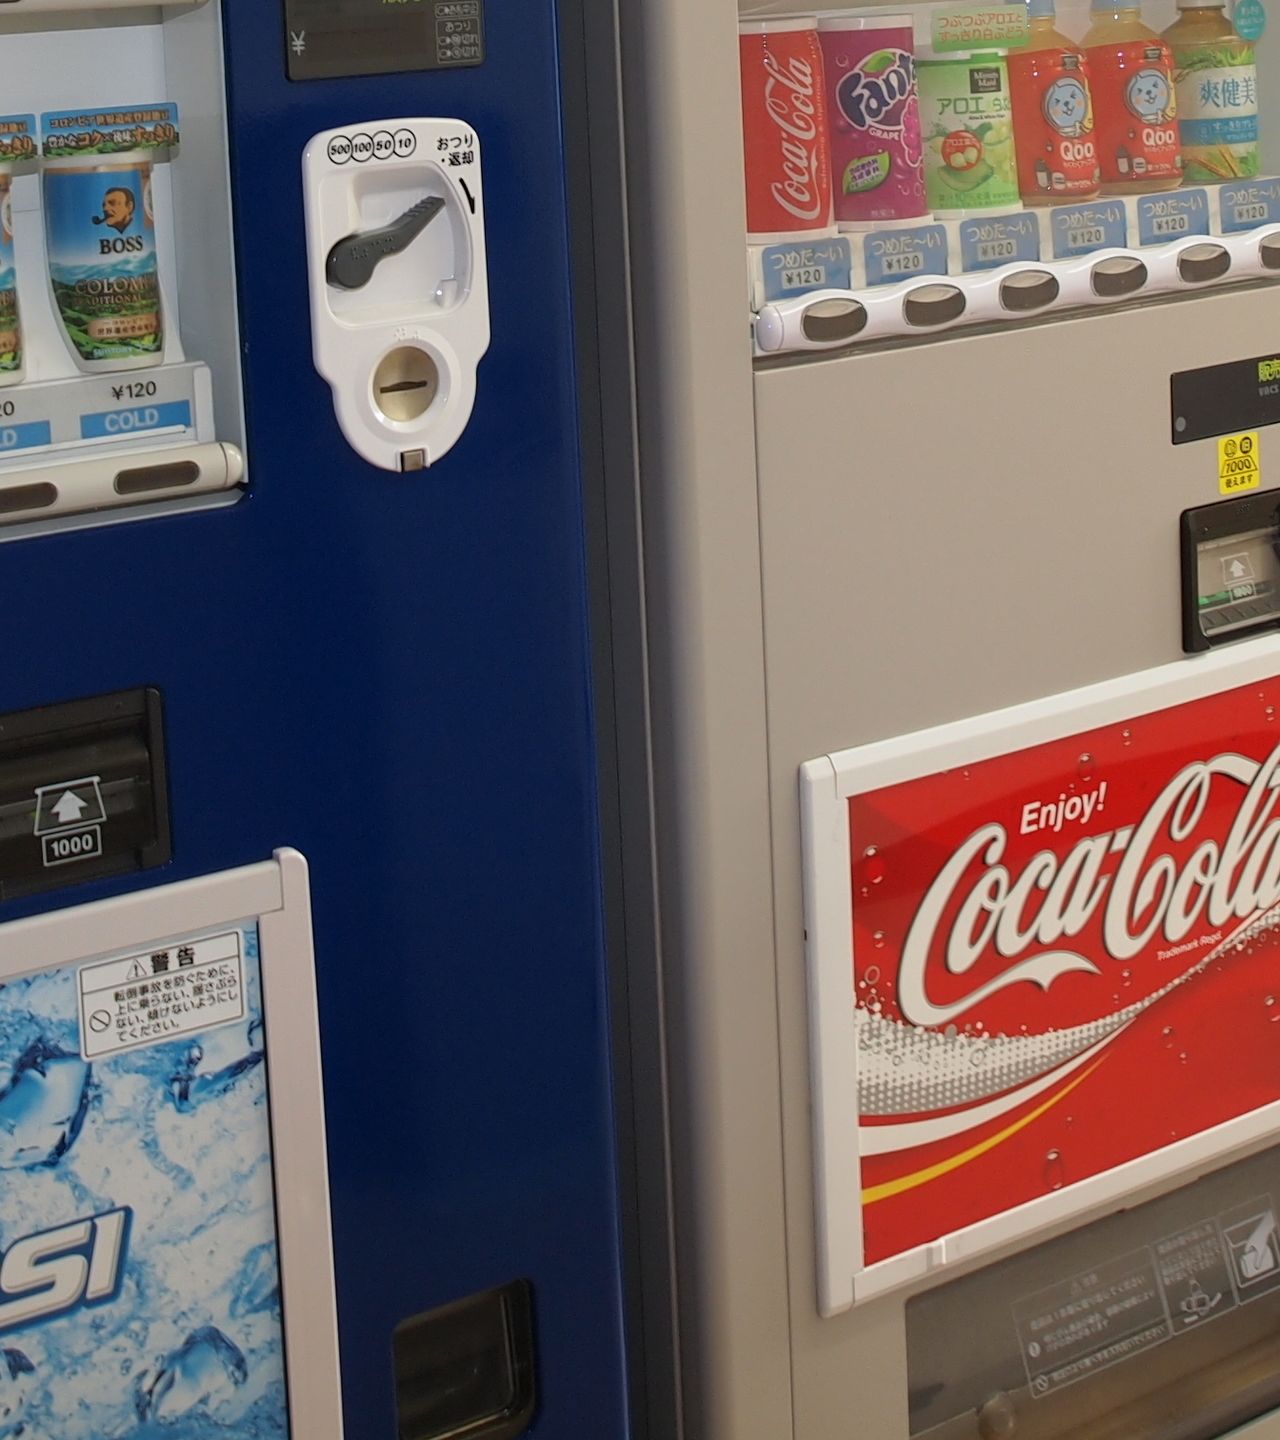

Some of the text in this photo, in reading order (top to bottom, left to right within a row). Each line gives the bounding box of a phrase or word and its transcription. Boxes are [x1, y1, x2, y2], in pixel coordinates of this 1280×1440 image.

[937, 96, 984, 115] アロエ
[437, 134, 473, 151] おつり
[765, 50, 821, 221] Coca-Cola
[870, 128, 899, 141] GRAPE
[1142, 129, 1175, 146] Qoo
[331, 138, 411, 155] 500 100 50 10
[1060, 142, 1093, 158] Qoo
[99, 236, 143, 255] BOSS
[111, 382, 156, 400] ¥120
[1225, 458, 1252, 474] 1000
[1019, 782, 1109, 836] Enjoy!
[51, 835, 93, 858] 1000
[151, 946, 195, 973] 警告
